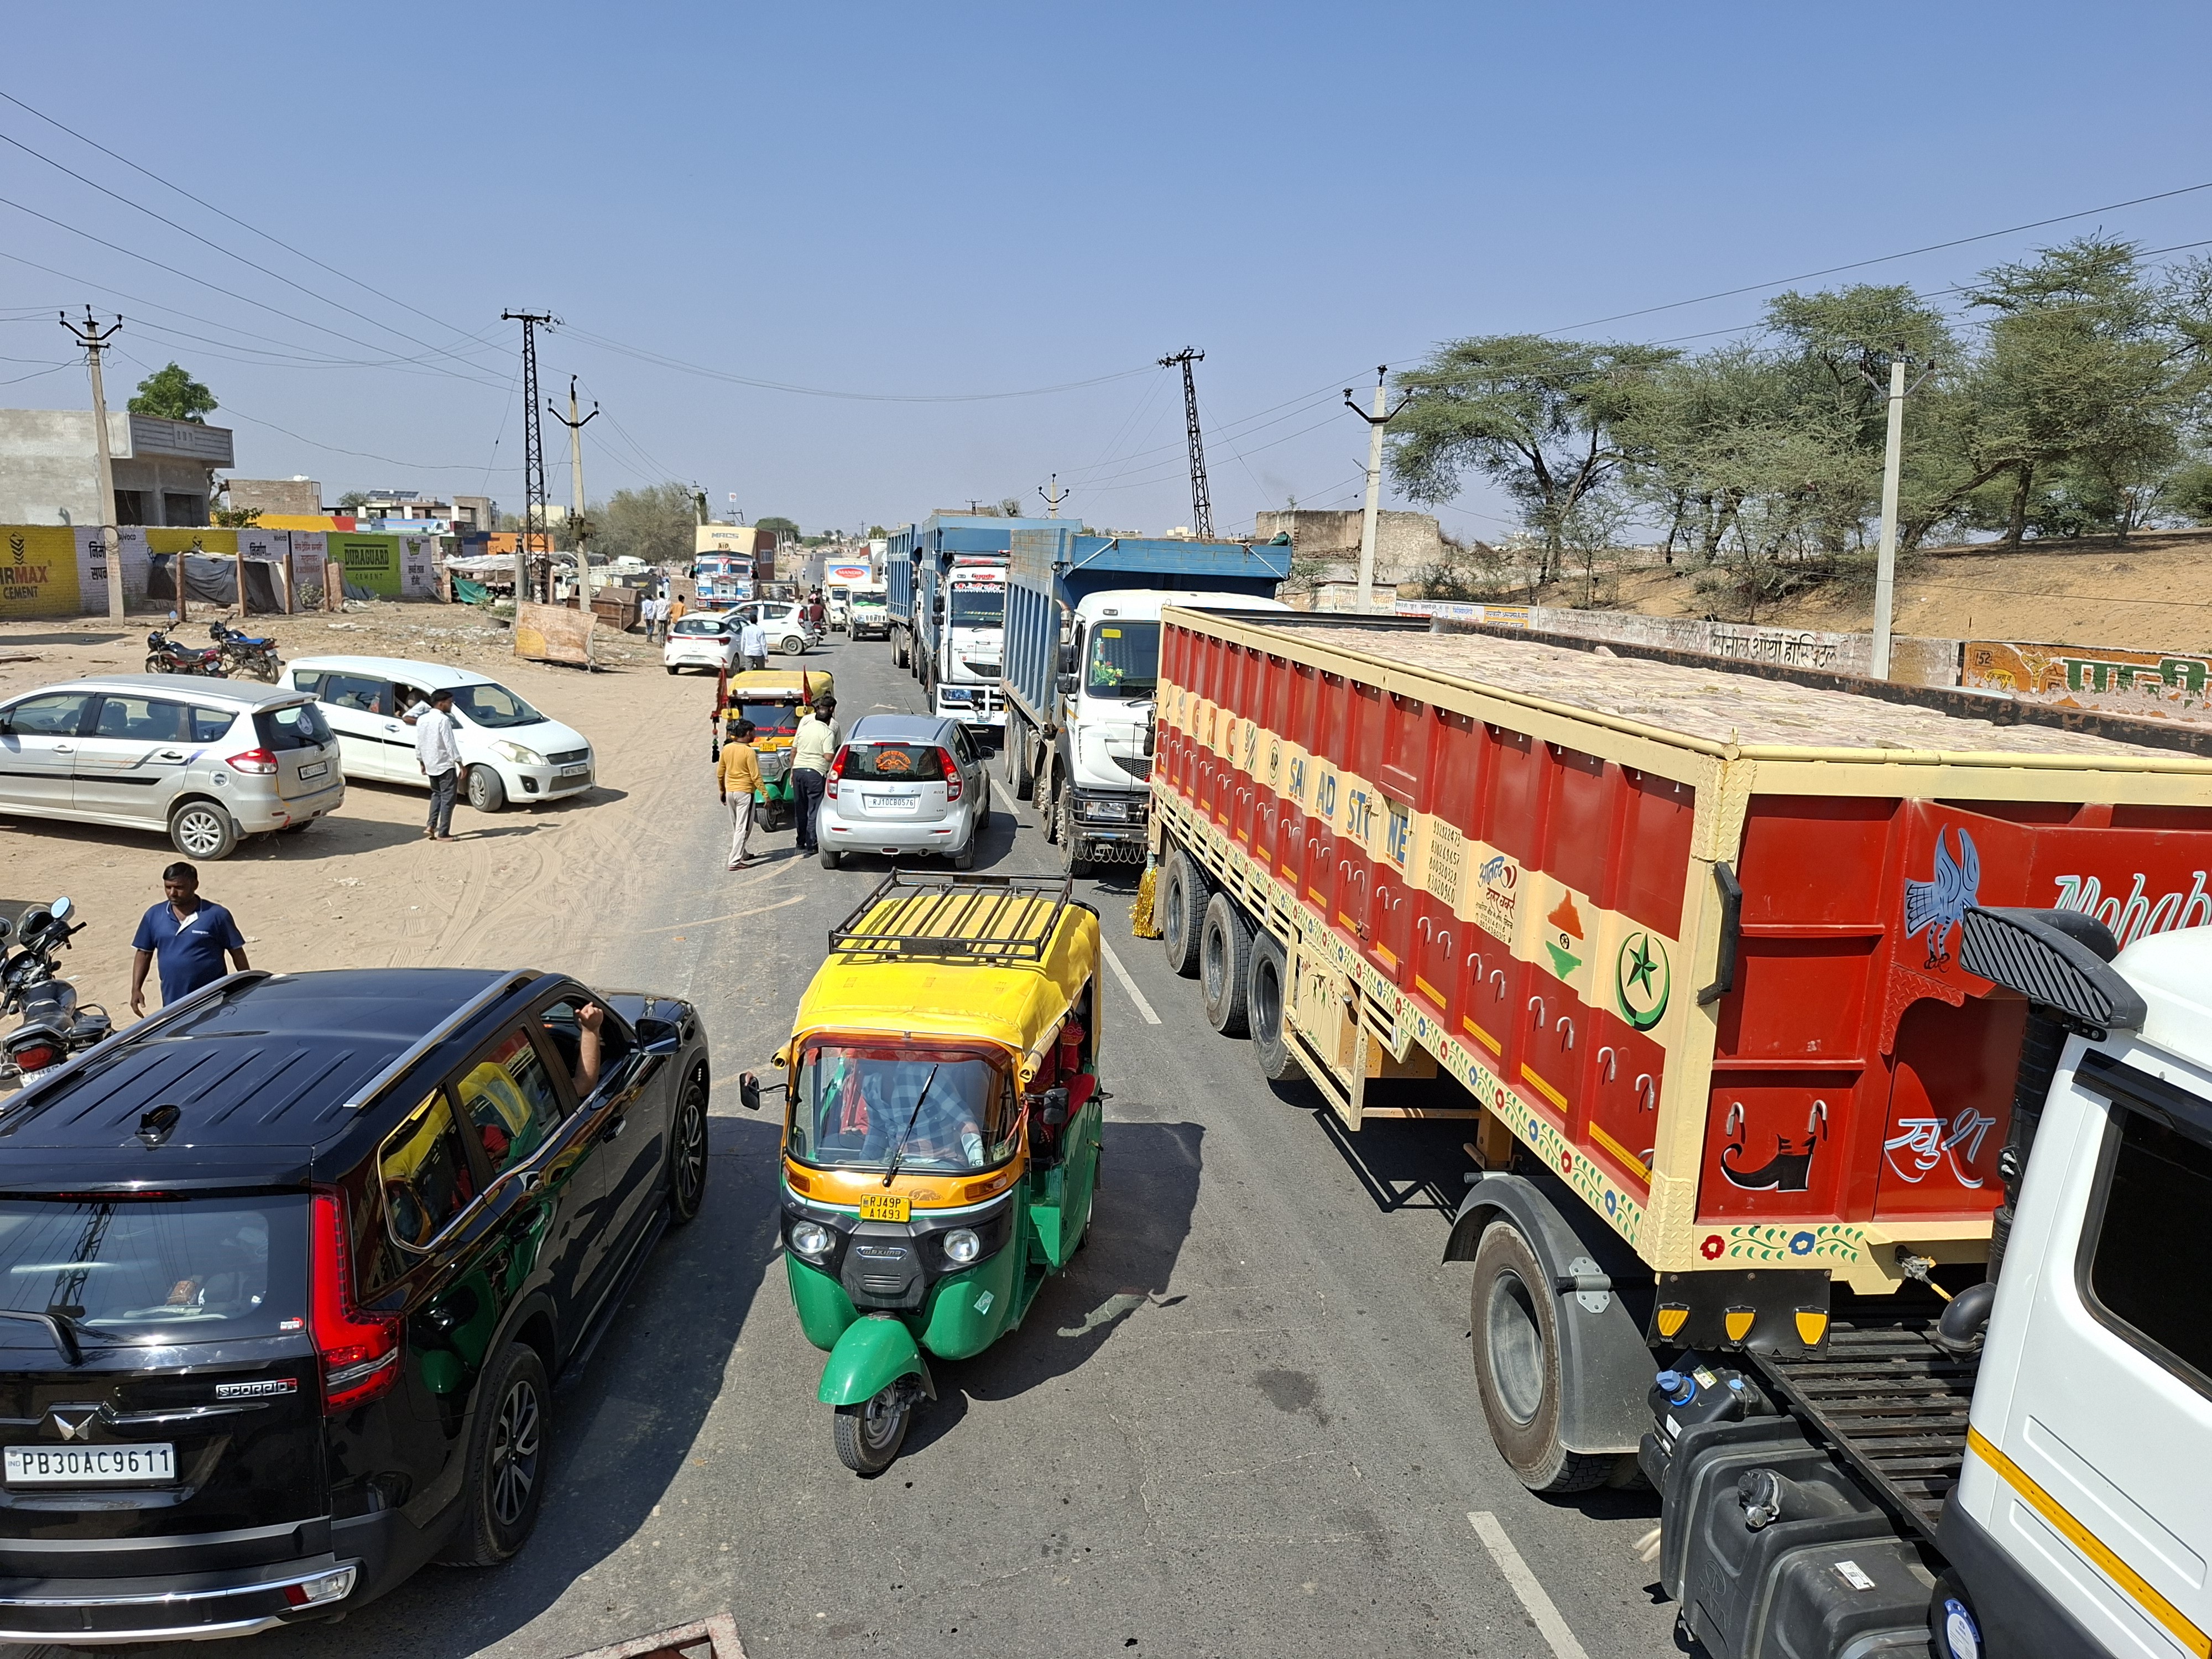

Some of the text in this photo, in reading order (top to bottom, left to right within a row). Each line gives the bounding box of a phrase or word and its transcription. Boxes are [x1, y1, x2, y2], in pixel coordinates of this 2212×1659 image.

[345, 549, 389, 566] DURAGUARD
[3, 586, 38, 600] CEMENT
[1976, 653, 1991, 665] 152
[873, 798, 914, 806] RJ10CB0576
[2053, 870, 2212, 951] Mohab
[870, 1196, 901, 1208] RJ49P
[869, 1208, 900, 1219] A1493
[979, 1296, 990, 1307] LPG
[219, 1383, 288, 1397] SCORPIO
[23, 1450, 168, 1475] PB30AC9611
